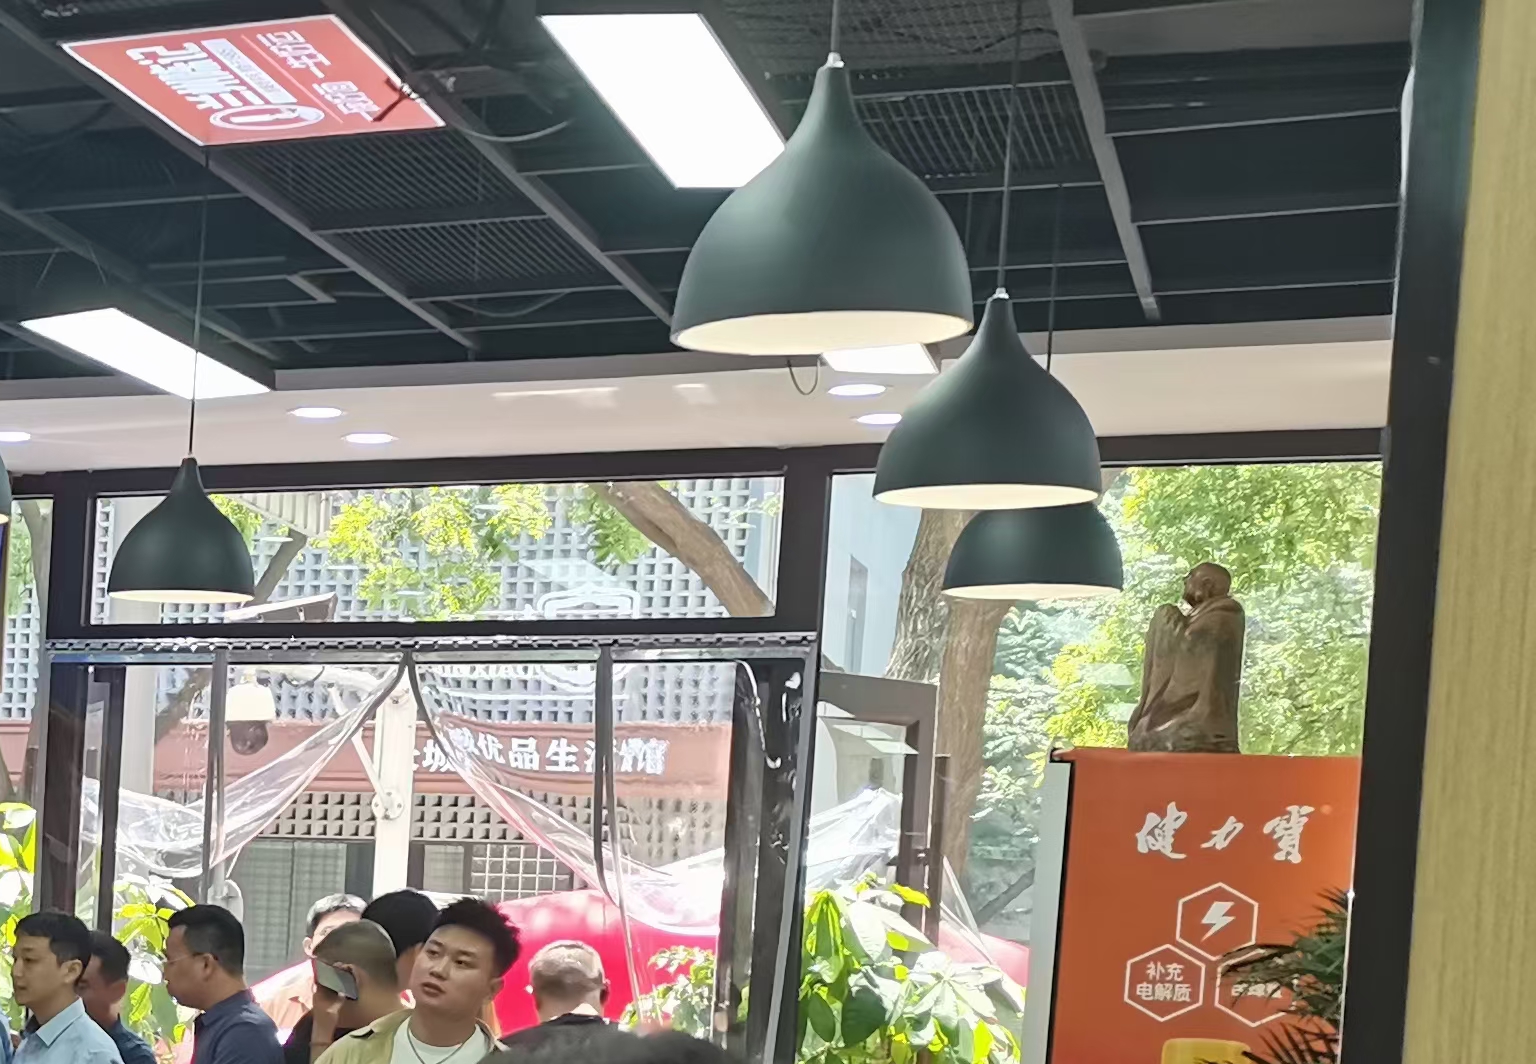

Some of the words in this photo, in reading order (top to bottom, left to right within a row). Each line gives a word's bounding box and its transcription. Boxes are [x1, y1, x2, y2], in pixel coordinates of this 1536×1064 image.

[1146, 961, 1185, 982] 补充
[1136, 982, 1192, 1002] 电解质
